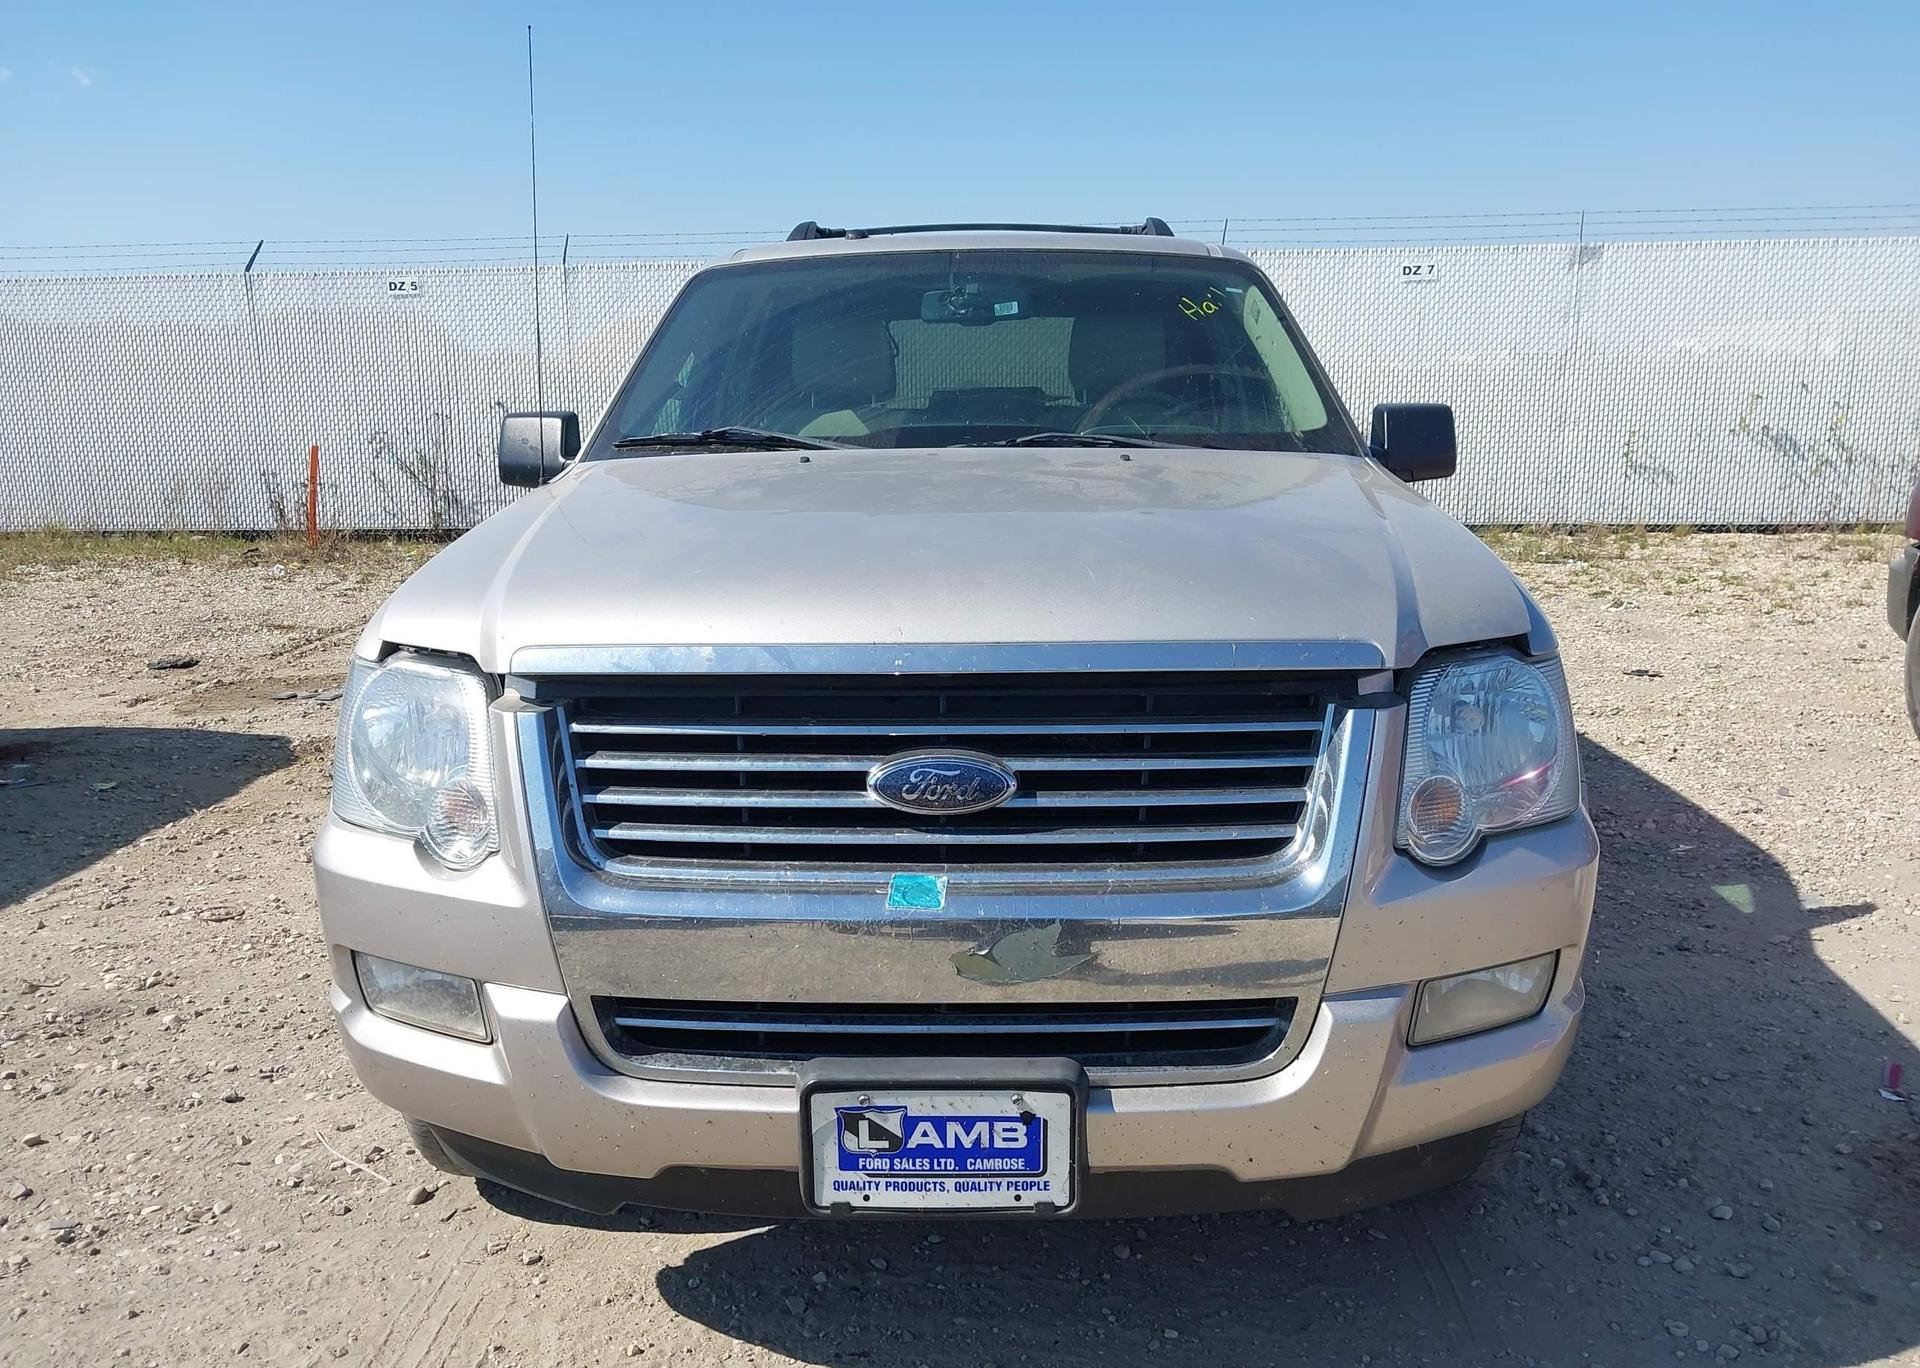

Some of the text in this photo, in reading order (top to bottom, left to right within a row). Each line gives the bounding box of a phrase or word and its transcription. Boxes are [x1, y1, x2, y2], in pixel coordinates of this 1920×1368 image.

[1402, 264, 1435, 276] DZ 7
[389, 281, 418, 291] DZ 5
[901, 768, 980, 801] Ford
[858, 1119, 1028, 1149] LAMB
[858, 1157, 890, 1170] FORD
[893, 1157, 930, 1170] SALES
[933, 1157, 959, 1170] LTD.
[832, 1179, 1051, 1194] QUALITY PRODUCTS, QUALITY PEOPLE
